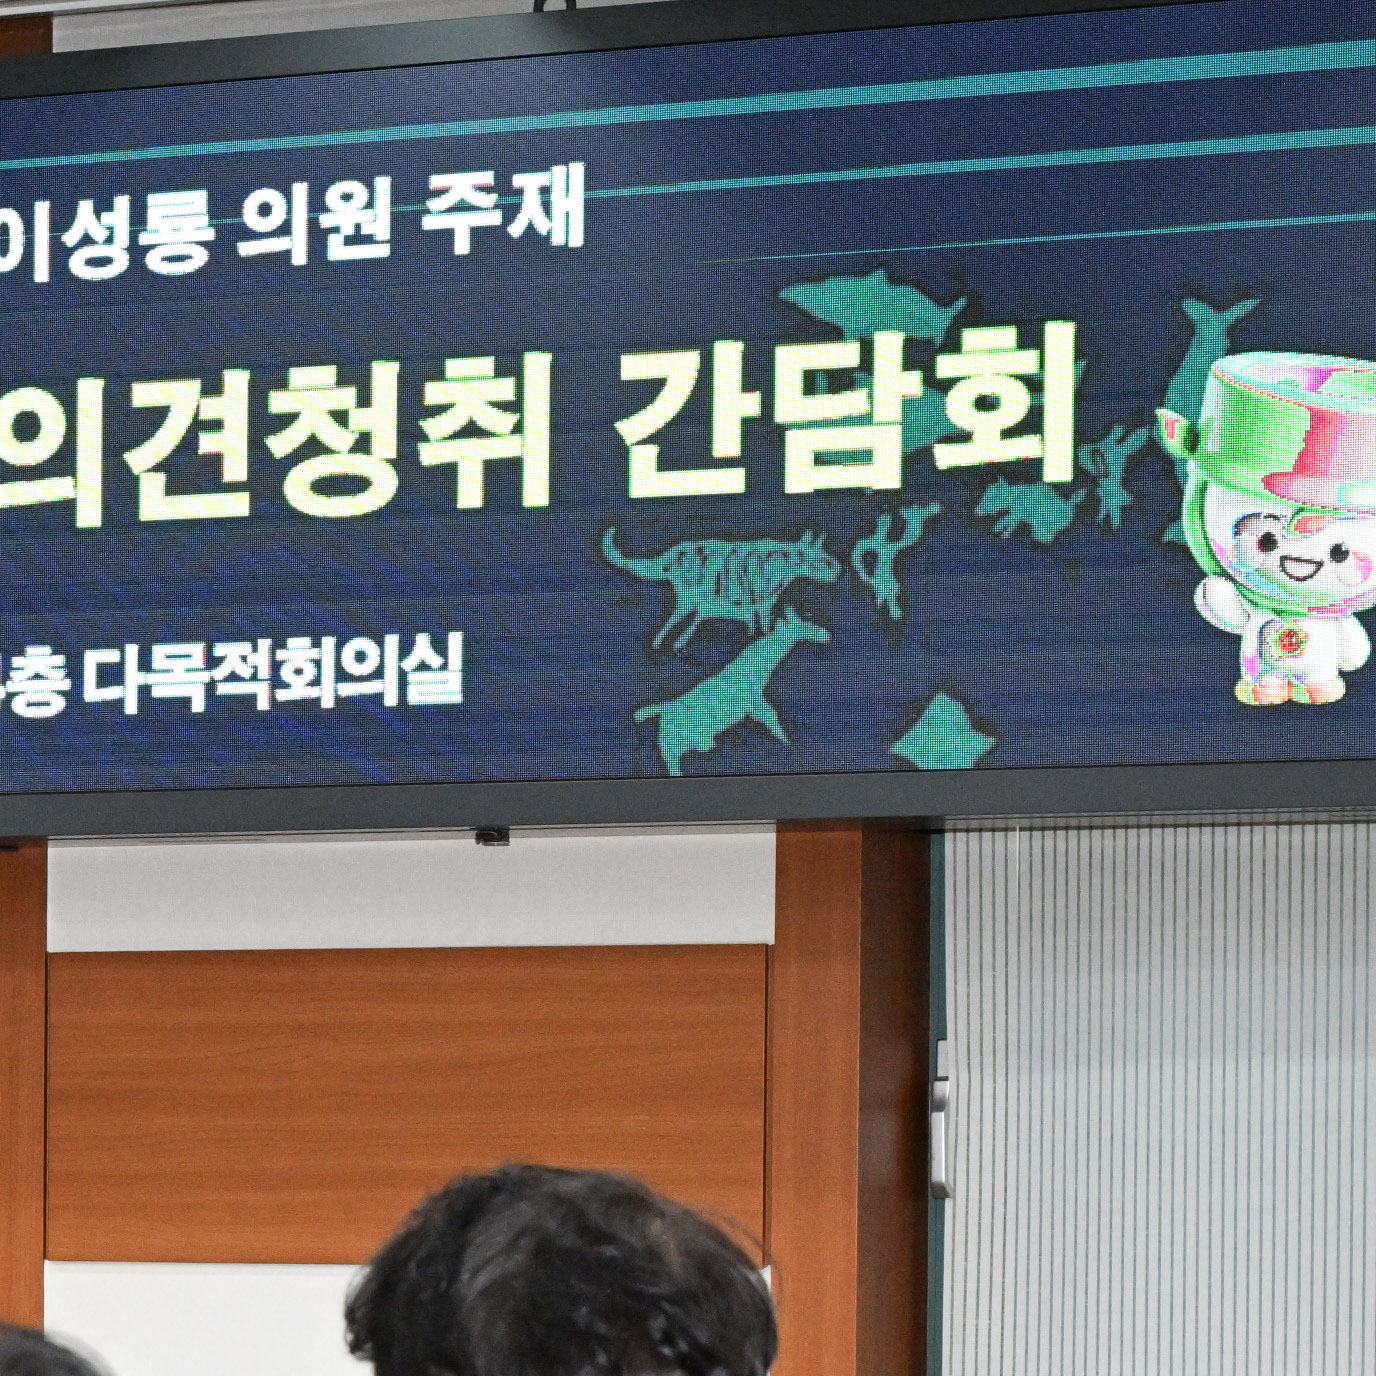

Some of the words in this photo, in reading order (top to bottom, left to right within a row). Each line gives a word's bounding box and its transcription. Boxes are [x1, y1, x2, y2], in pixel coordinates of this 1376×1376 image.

[235, 174, 393, 266] 의원
[419, 160, 586, 256] 주재
[611, 319, 1077, 500] 간담회
[82, 630, 464, 715] 다목적회의실
